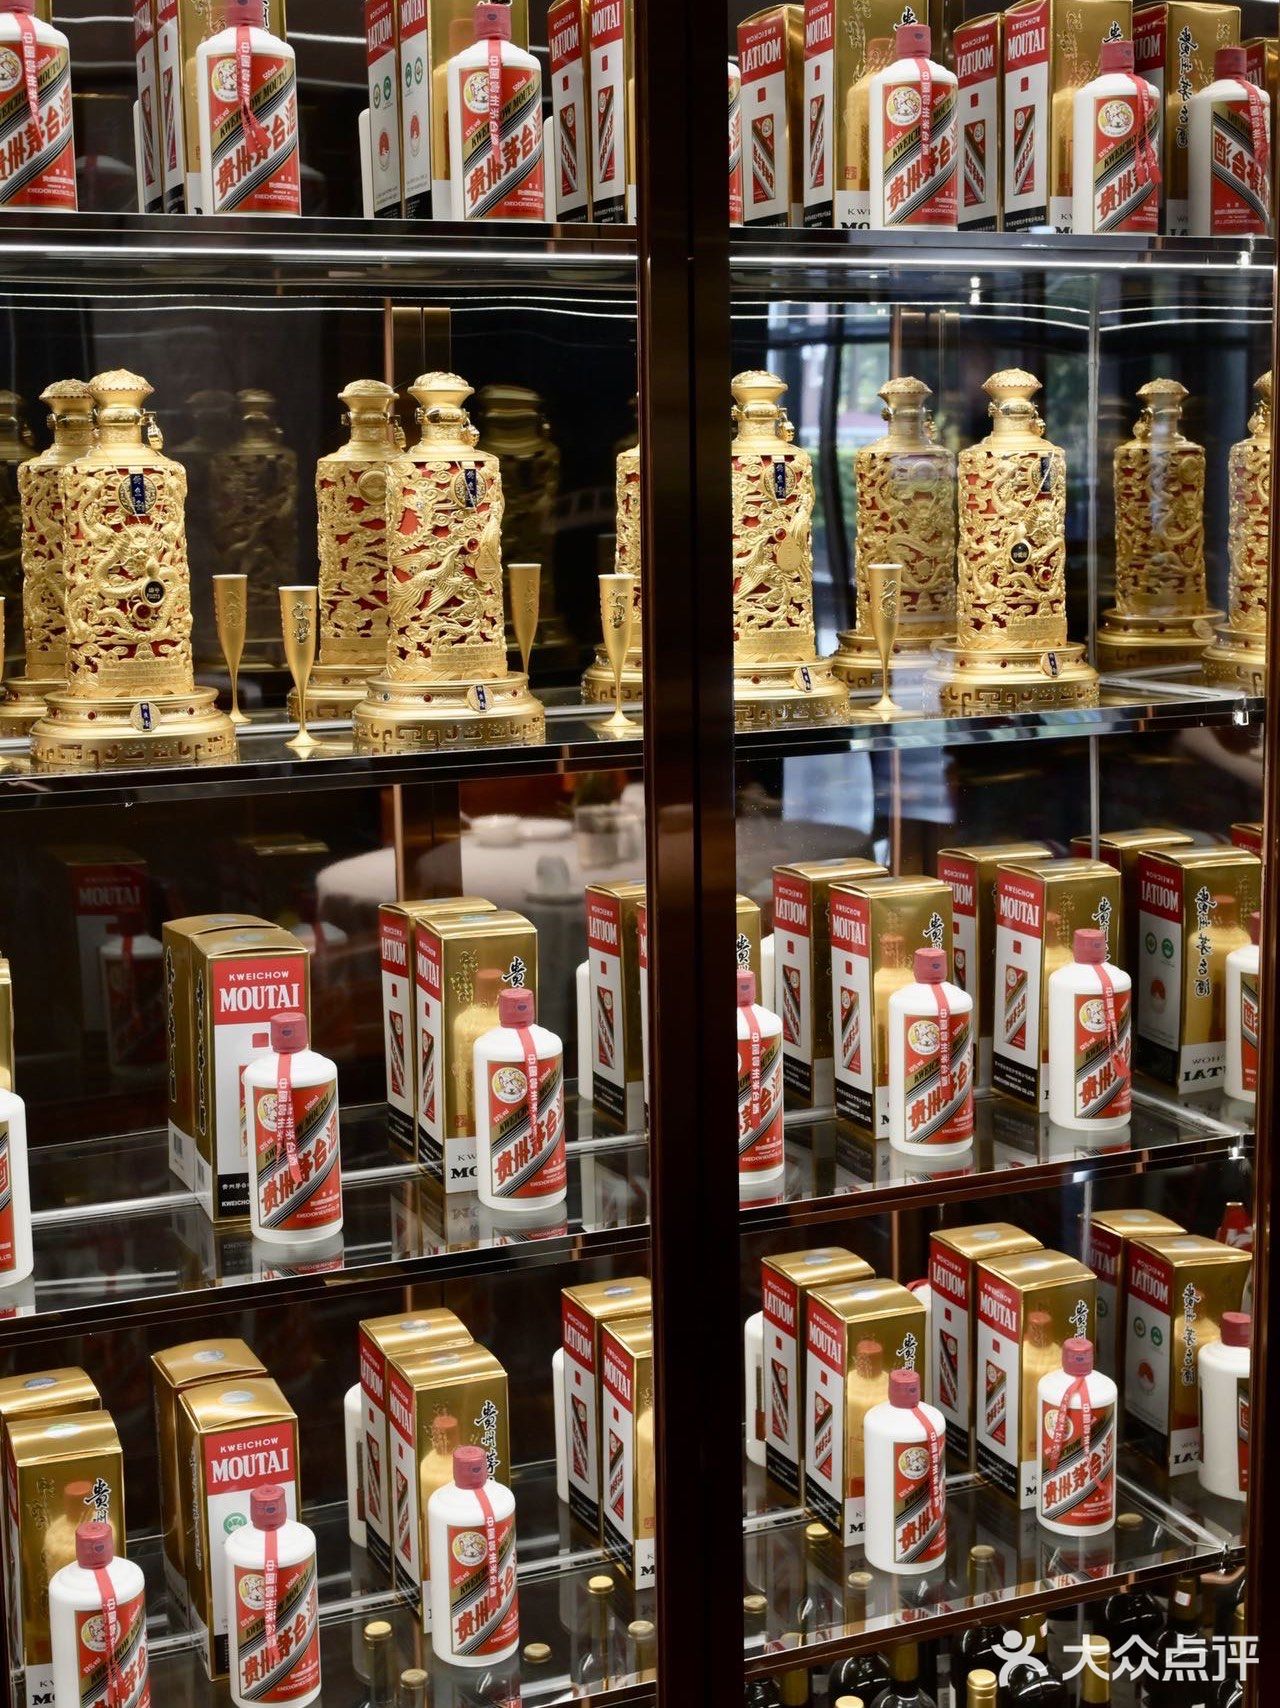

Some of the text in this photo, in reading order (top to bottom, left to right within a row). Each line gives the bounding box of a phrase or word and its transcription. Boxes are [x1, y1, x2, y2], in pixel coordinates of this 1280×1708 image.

[592, 3, 620, 37] MOUTAI
[806, 13, 832, 48] MOUTAI
[1008, 25, 1046, 60] MOUTAI
[1000, 894, 1039, 927] MOUTAI
[833, 914, 866, 945] MOUTAI
[229, 971, 289, 981] KWEICHOW
[219, 983, 300, 1013] MOUTAI
[980, 1291, 1017, 1332] MOUTAI
[809, 1321, 841, 1364] MOUTAI
[220, 1438, 279, 1453] KWEICHOW
[211, 1447, 290, 1484] MOUTAI
